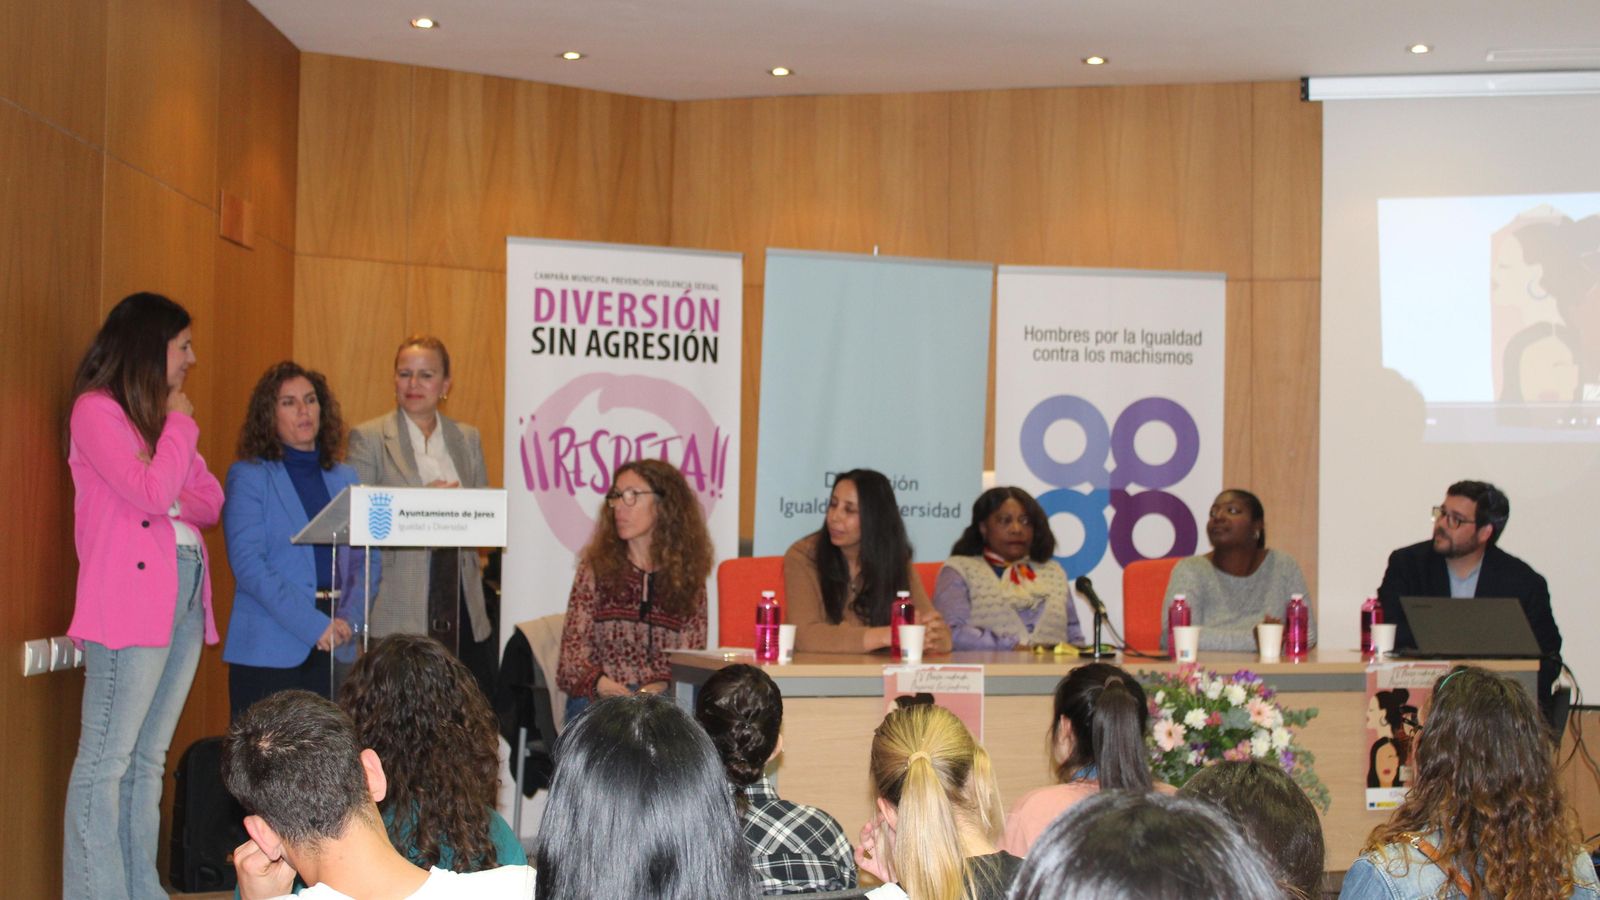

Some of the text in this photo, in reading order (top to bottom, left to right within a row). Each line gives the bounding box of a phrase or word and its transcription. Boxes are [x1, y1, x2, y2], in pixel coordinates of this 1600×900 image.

[534, 271, 719, 292] CAMPAÑA MUNICIPAL PREVENCIÓN VIOLENCIA SEXUAL
[533, 287, 720, 333] DIVERSIÓN
[531, 327, 719, 364] SIN AGRESIÓN
[1024, 325, 1203, 348] Hombres por la Igualdad
[1033, 346, 1194, 366] contra los machismos
[399, 508, 495, 519] Ayuntamiento de Jerez
[780, 496, 829, 519] Iguald
